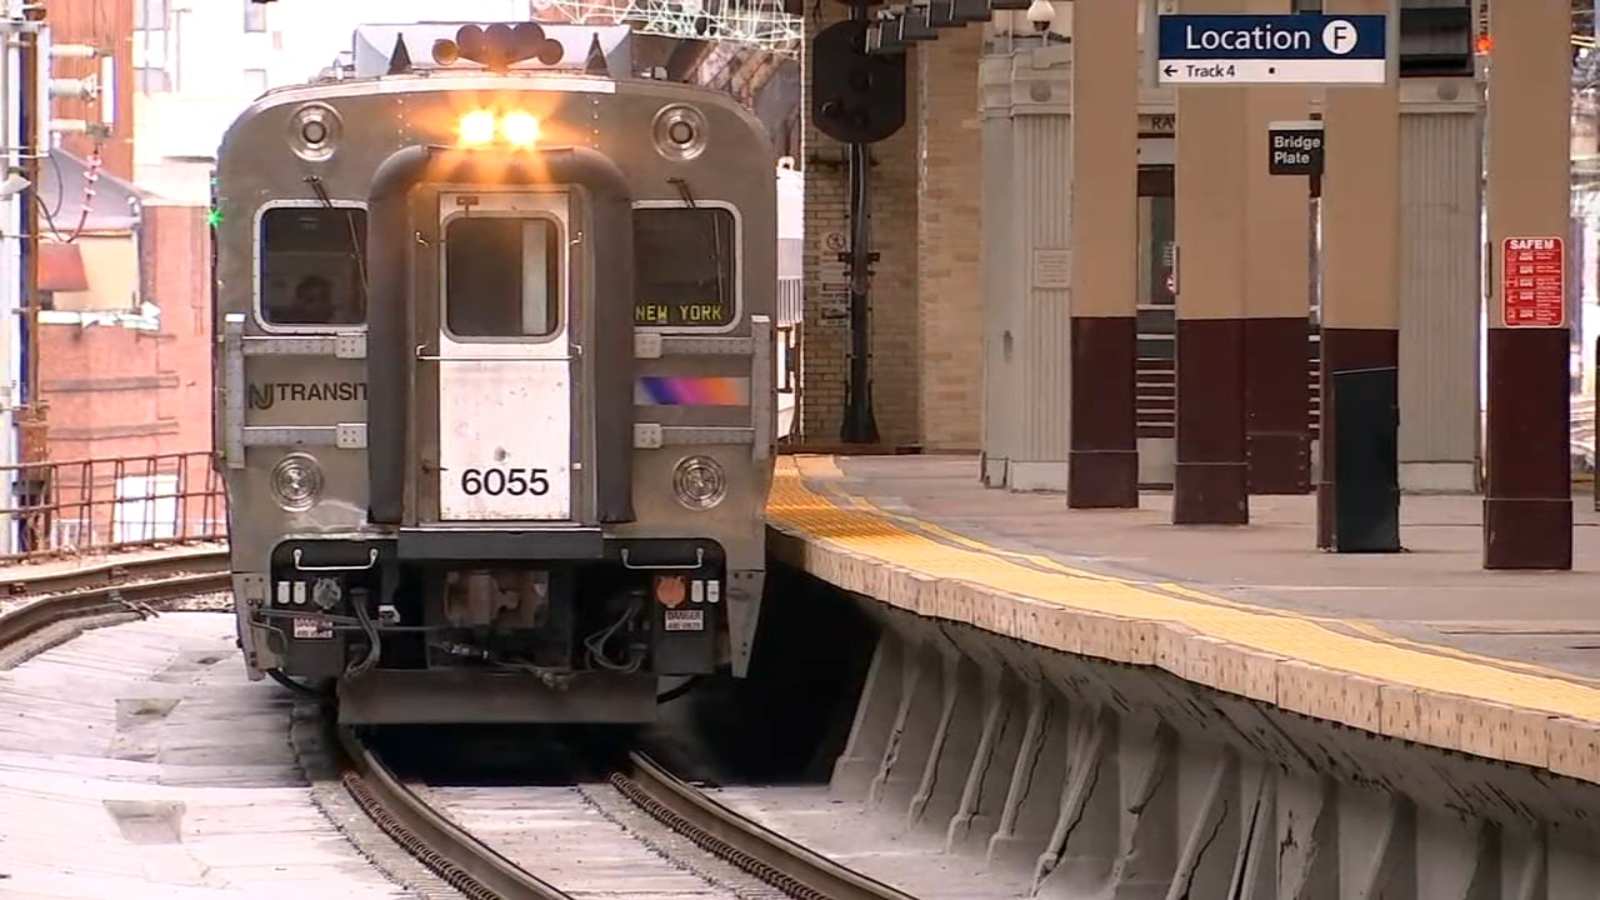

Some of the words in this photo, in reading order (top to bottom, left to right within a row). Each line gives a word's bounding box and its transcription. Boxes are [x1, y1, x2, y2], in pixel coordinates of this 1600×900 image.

[1186, 24, 1311, 50] Location
[1186, 65, 1225, 78] Track
[1226, 65, 1236, 78] 4
[1274, 136, 1321, 150] Bridge
[1274, 151, 1310, 164] Plate
[635, 305, 668, 321] NEW
[679, 305, 721, 321] YORK
[248, 383, 274, 410] NJ
[461, 468, 549, 496] 6055
